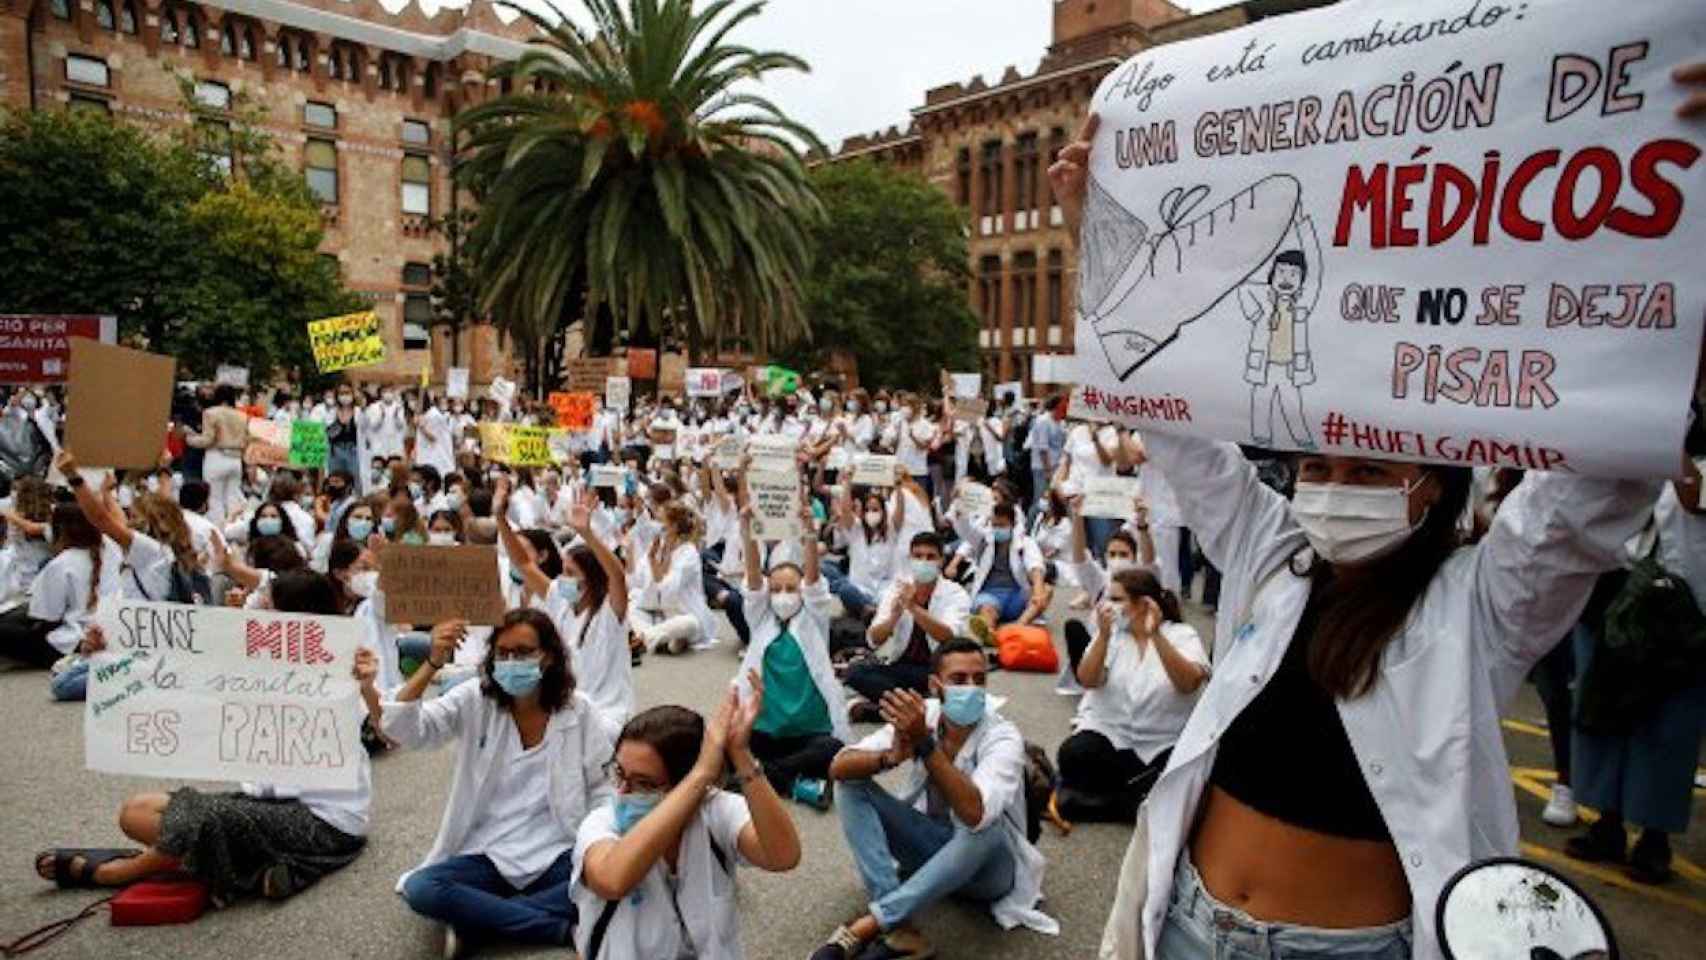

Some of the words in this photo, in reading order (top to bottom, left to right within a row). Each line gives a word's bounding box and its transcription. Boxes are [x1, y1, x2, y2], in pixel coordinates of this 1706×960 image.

[1104, 61, 1175, 111] Algo
[1206, 38, 1275, 82] está
[1115, 119, 1178, 169] UNA
[1193, 60, 1504, 158] GENERACIÓN
[1546, 39, 1650, 123] DE
[1333, 138, 1702, 249] MÉDICOS
[1340, 282, 1405, 323] QUE
[1416, 287, 1468, 326] NO
[1476, 284, 1526, 326] SE
[1546, 281, 1677, 329] DEJA
[1392, 341, 1561, 409] PISAR
[117, 606, 204, 654] SENSE
[245, 618, 335, 665] MIR
[149, 655, 187, 690] la
[126, 709, 181, 757] ES
[217, 701, 346, 768] PARA
